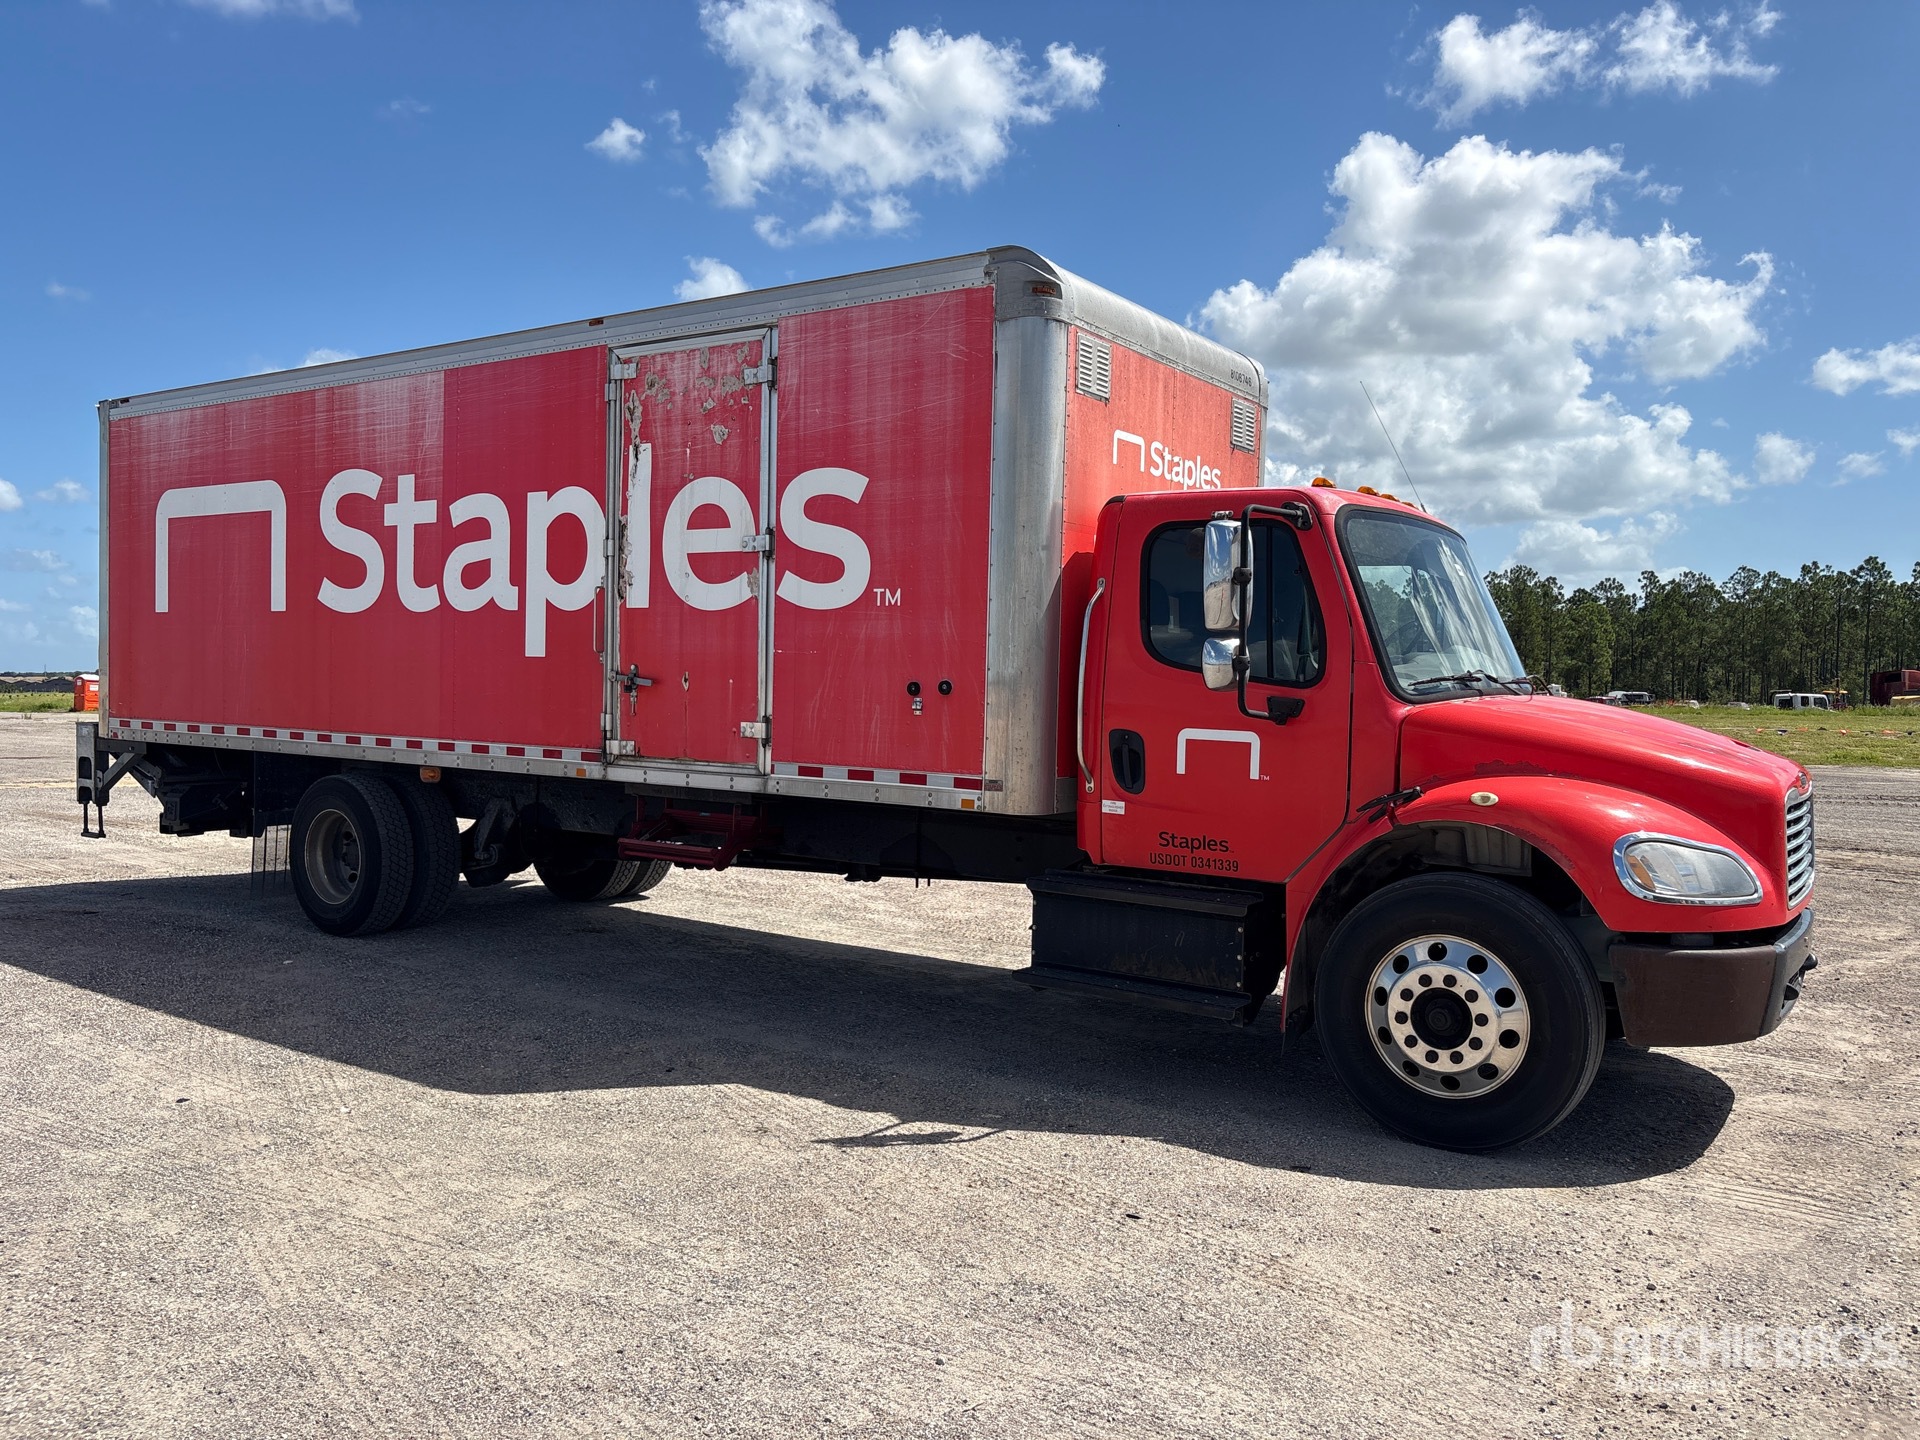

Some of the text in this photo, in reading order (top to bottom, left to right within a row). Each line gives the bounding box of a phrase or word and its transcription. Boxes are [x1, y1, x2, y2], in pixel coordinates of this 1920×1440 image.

[1150, 441, 1221, 490] Staples
[317, 443, 871, 657] Staples
[1158, 831, 1229, 854] Staples
[1149, 852, 1239, 872] USDOT 0341339
